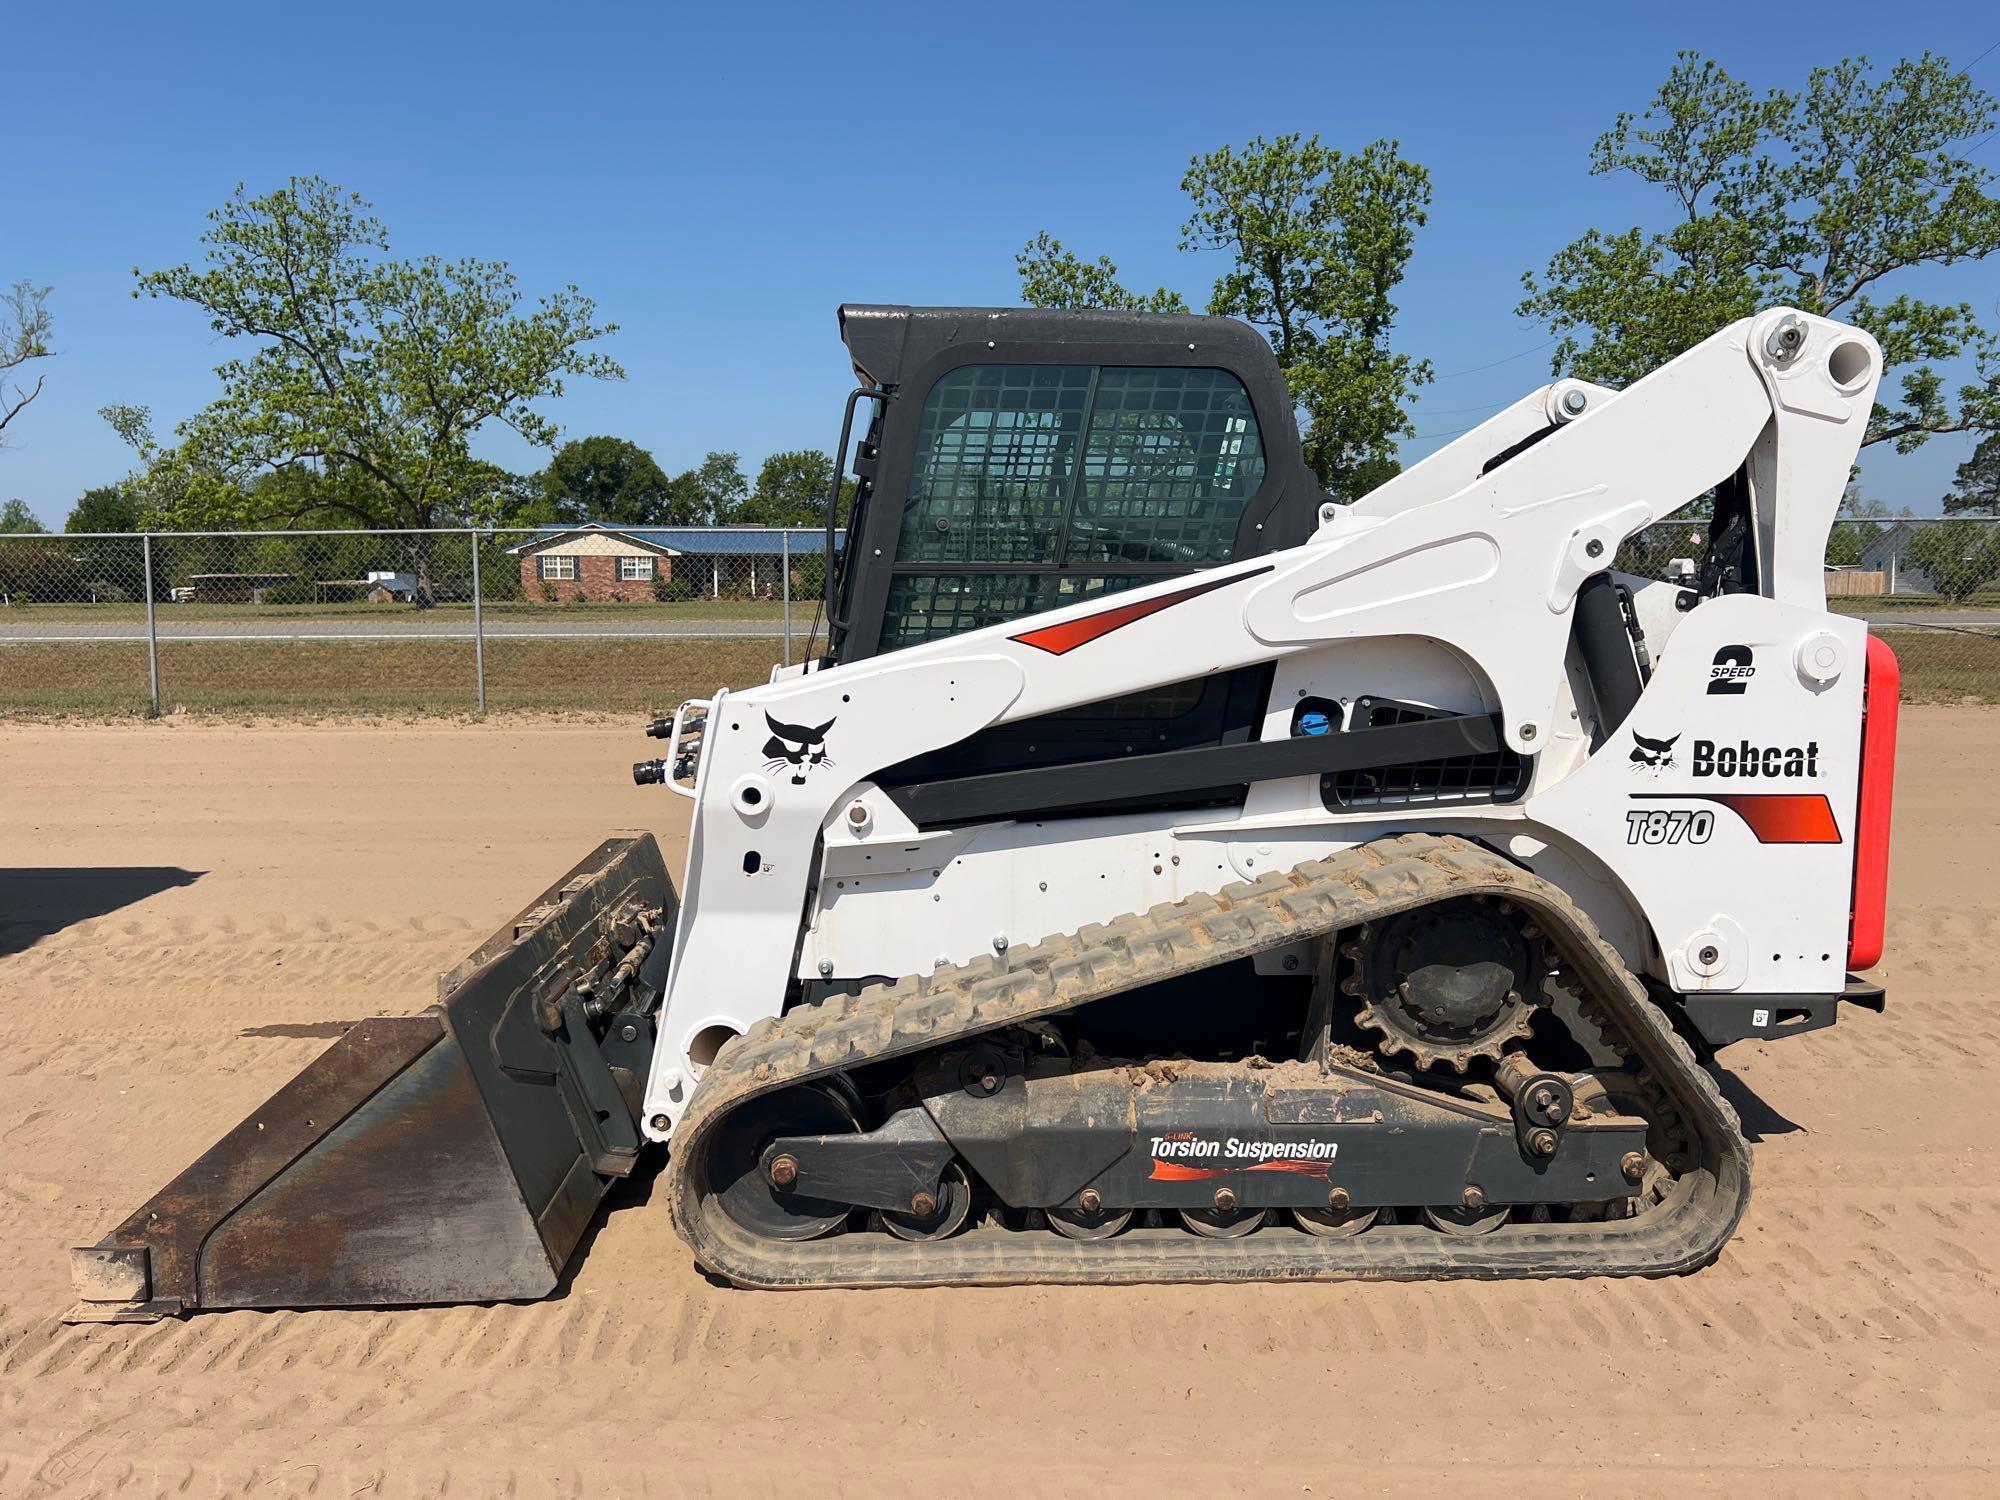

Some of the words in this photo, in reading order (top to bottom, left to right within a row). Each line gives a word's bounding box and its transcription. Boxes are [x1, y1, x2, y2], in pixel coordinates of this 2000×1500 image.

[1706, 644, 1754, 695] 2
[1710, 667, 1756, 678] SPEED
[1692, 740, 1819, 777] Bobcat
[1626, 810, 1715, 845] T870
[1150, 1137, 1220, 1157] Torsion
[1224, 1137, 1338, 1162] Suspension
